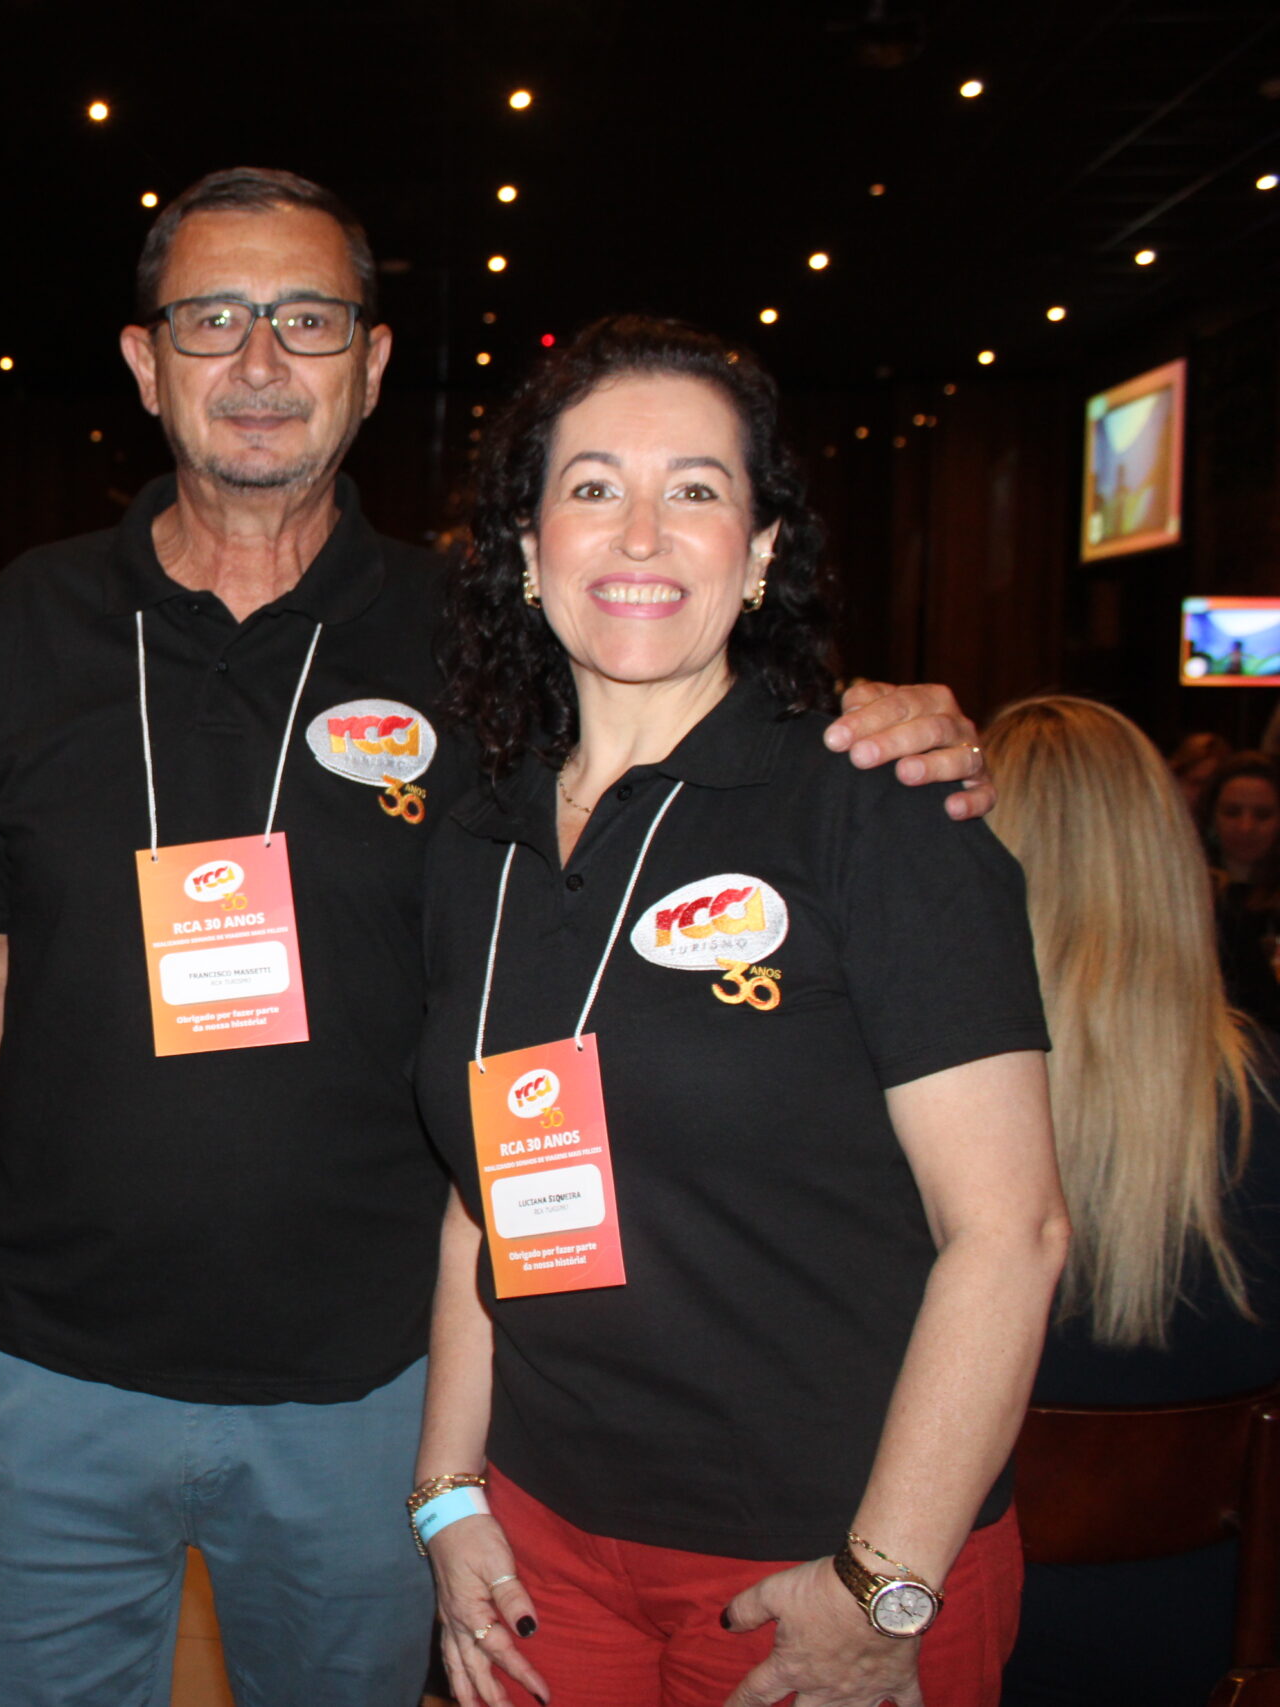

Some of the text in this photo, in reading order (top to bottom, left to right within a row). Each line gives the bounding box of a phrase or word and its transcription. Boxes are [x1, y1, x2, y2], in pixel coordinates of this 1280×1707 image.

[327, 715, 420, 757] rca
[173, 913, 265, 934] RCA 30 ANOS
[655, 886, 767, 948] rca
[189, 967, 271, 979] FRANCISCO MASSETTI
[749, 965, 782, 980] ANOS
[500, 1131, 580, 1156] RCA 30 ANOS
[518, 1192, 581, 1208] LUCIANA SIQUEIRA
